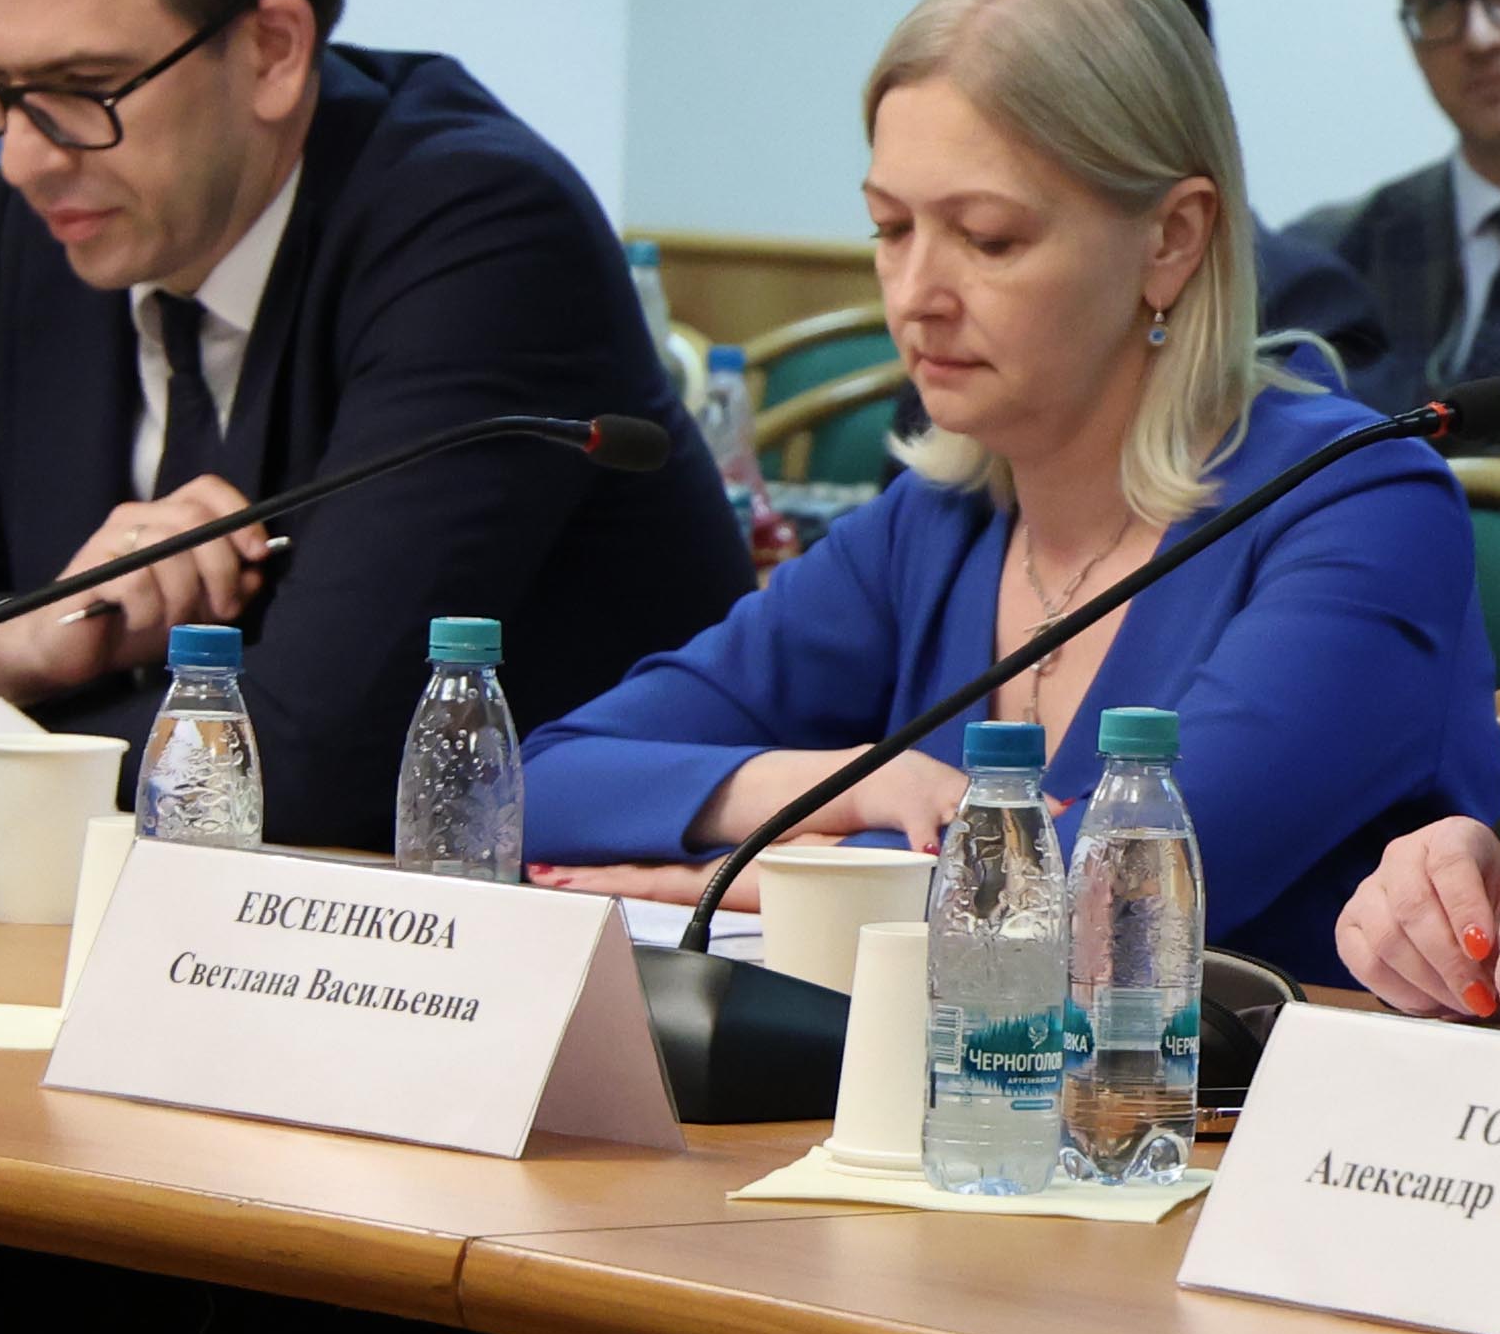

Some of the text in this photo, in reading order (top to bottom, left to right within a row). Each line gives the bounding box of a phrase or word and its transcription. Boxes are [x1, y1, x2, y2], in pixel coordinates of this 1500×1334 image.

[233, 890, 457, 951] ЕВСЕЕНКОВА
[168, 950, 480, 1023] Светлана Васильевна
[1306, 1149, 1496, 1221] Александр
